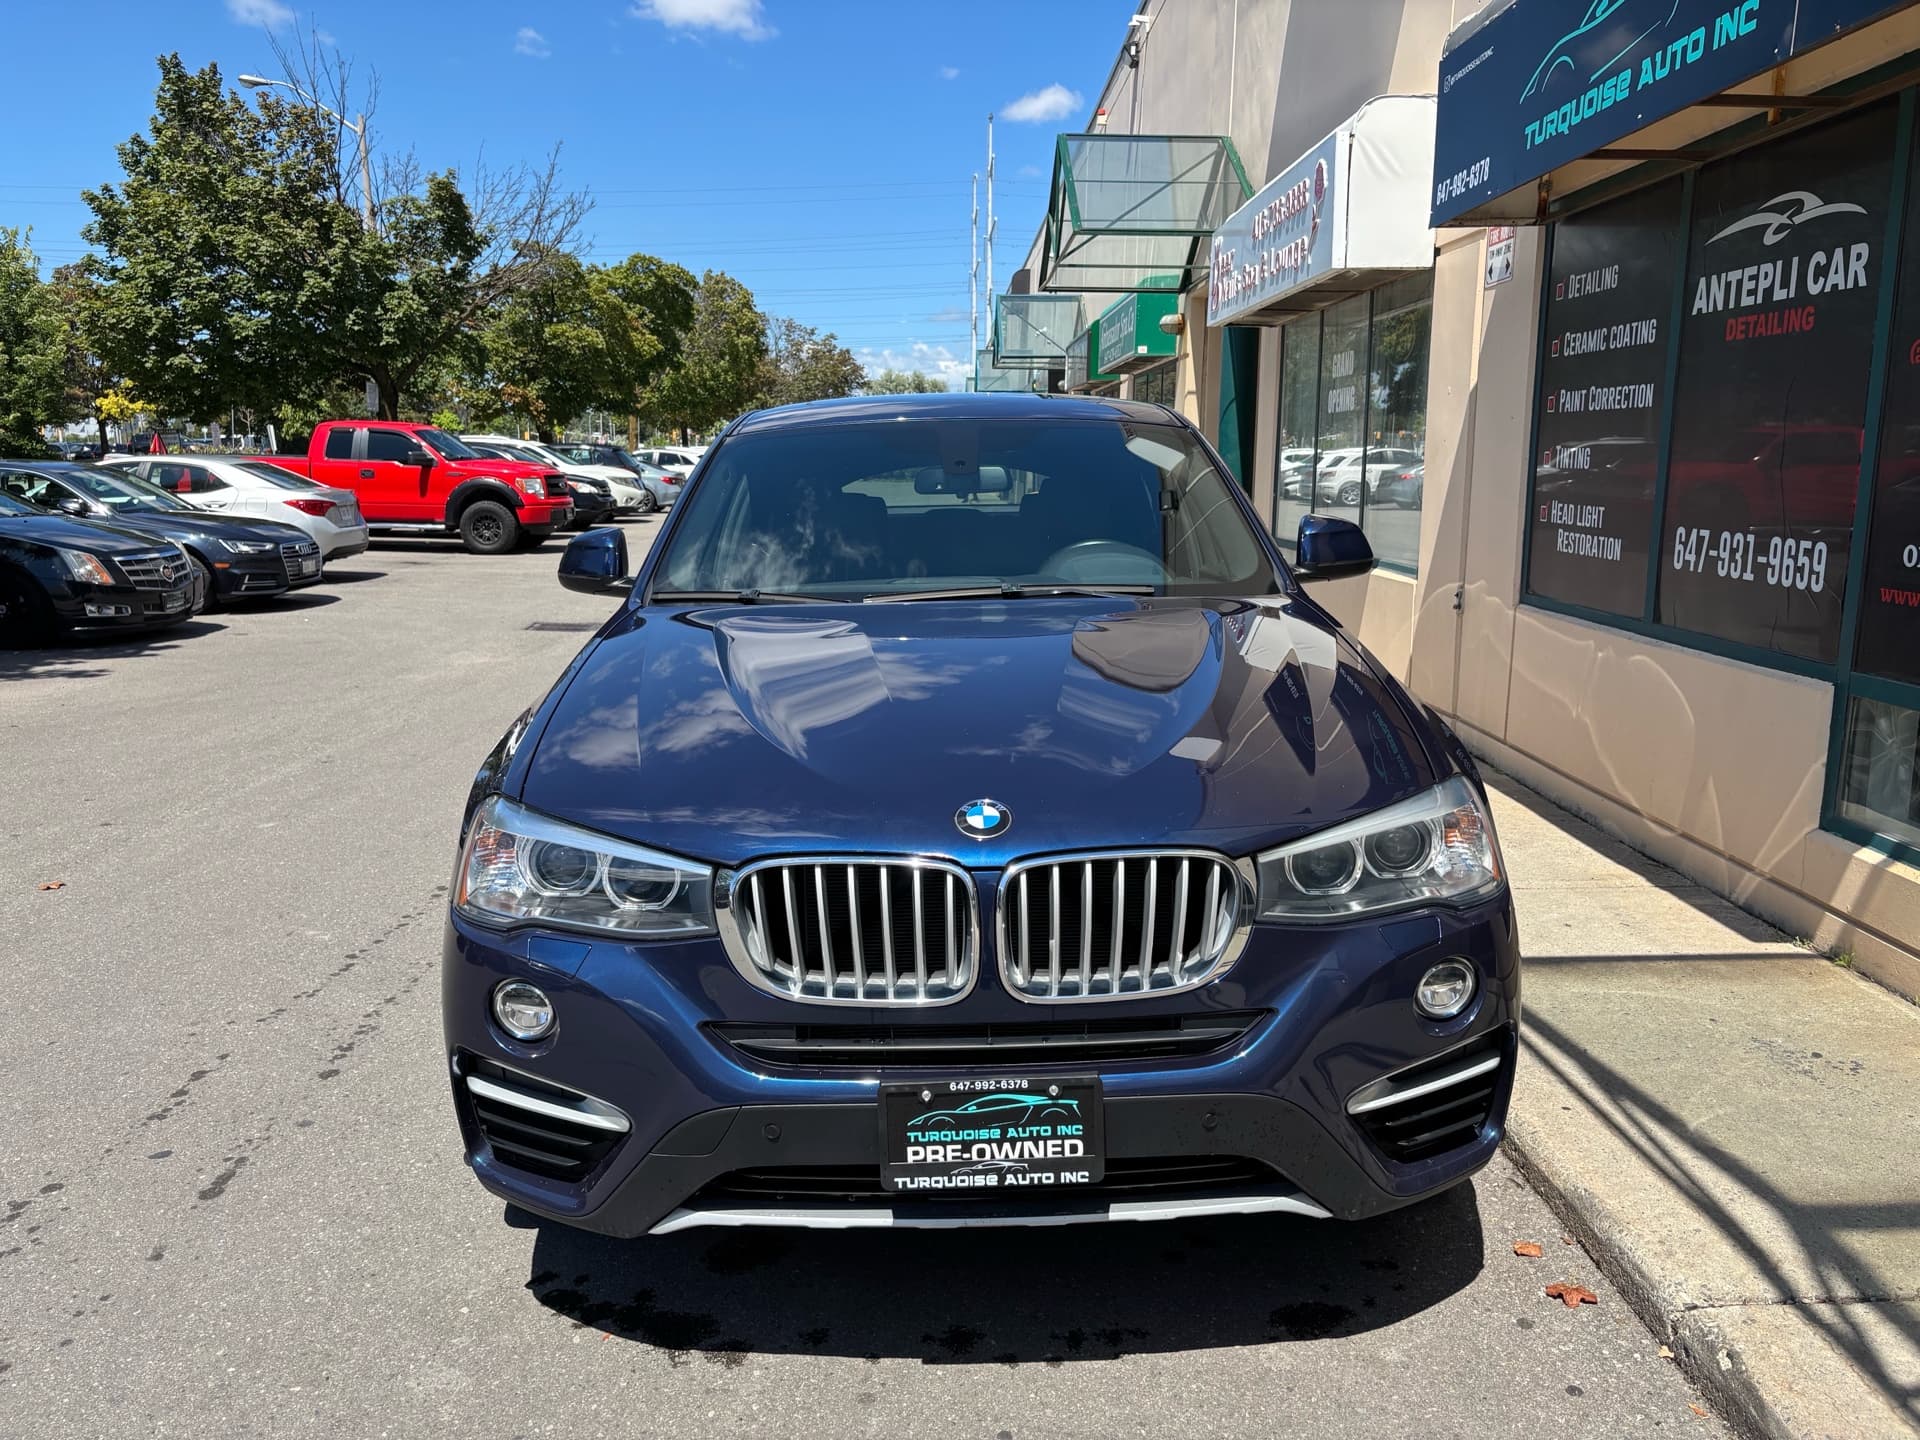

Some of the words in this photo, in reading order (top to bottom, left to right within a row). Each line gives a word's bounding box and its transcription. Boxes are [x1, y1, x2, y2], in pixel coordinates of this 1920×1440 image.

[1524, 70, 1631, 151] TURQUOISE
[1637, 26, 1705, 91] AUTO
[1713, 0, 1760, 51] INC
[1436, 156, 1490, 206] 647-992-6378
[1567, 265, 1619, 301] DETAILING
[1691, 256, 1799, 316] ANTEPLI
[1806, 242, 1870, 296] CAR
[1563, 329, 1607, 358] CERAMIC
[1609, 319, 1657, 350] COATING
[1724, 305, 1815, 342] DETAILING
[1559, 388, 1586, 413] PAINT
[1588, 383, 1654, 411] CORRECTION
[1555, 445, 1591, 470] TINTING
[1551, 500, 1574, 526] HEAD
[1576, 506, 1605, 529] LIGHT
[1557, 529, 1622, 561] RESTORATION
[1673, 526, 1828, 593] 647-931-9659
[949, 1079, 1029, 1092] 647-992-6378
[907, 1128, 1001, 1142] TURQUOISE
[1006, 1125, 1052, 1139] AUTO
[1057, 1124, 1083, 1136] INC
[906, 1138, 1084, 1163] PRE-OWNED
[894, 1172, 999, 1189] TURQUOISE
[1004, 1173, 1055, 1186] AUTO
[1060, 1171, 1090, 1184] INC
